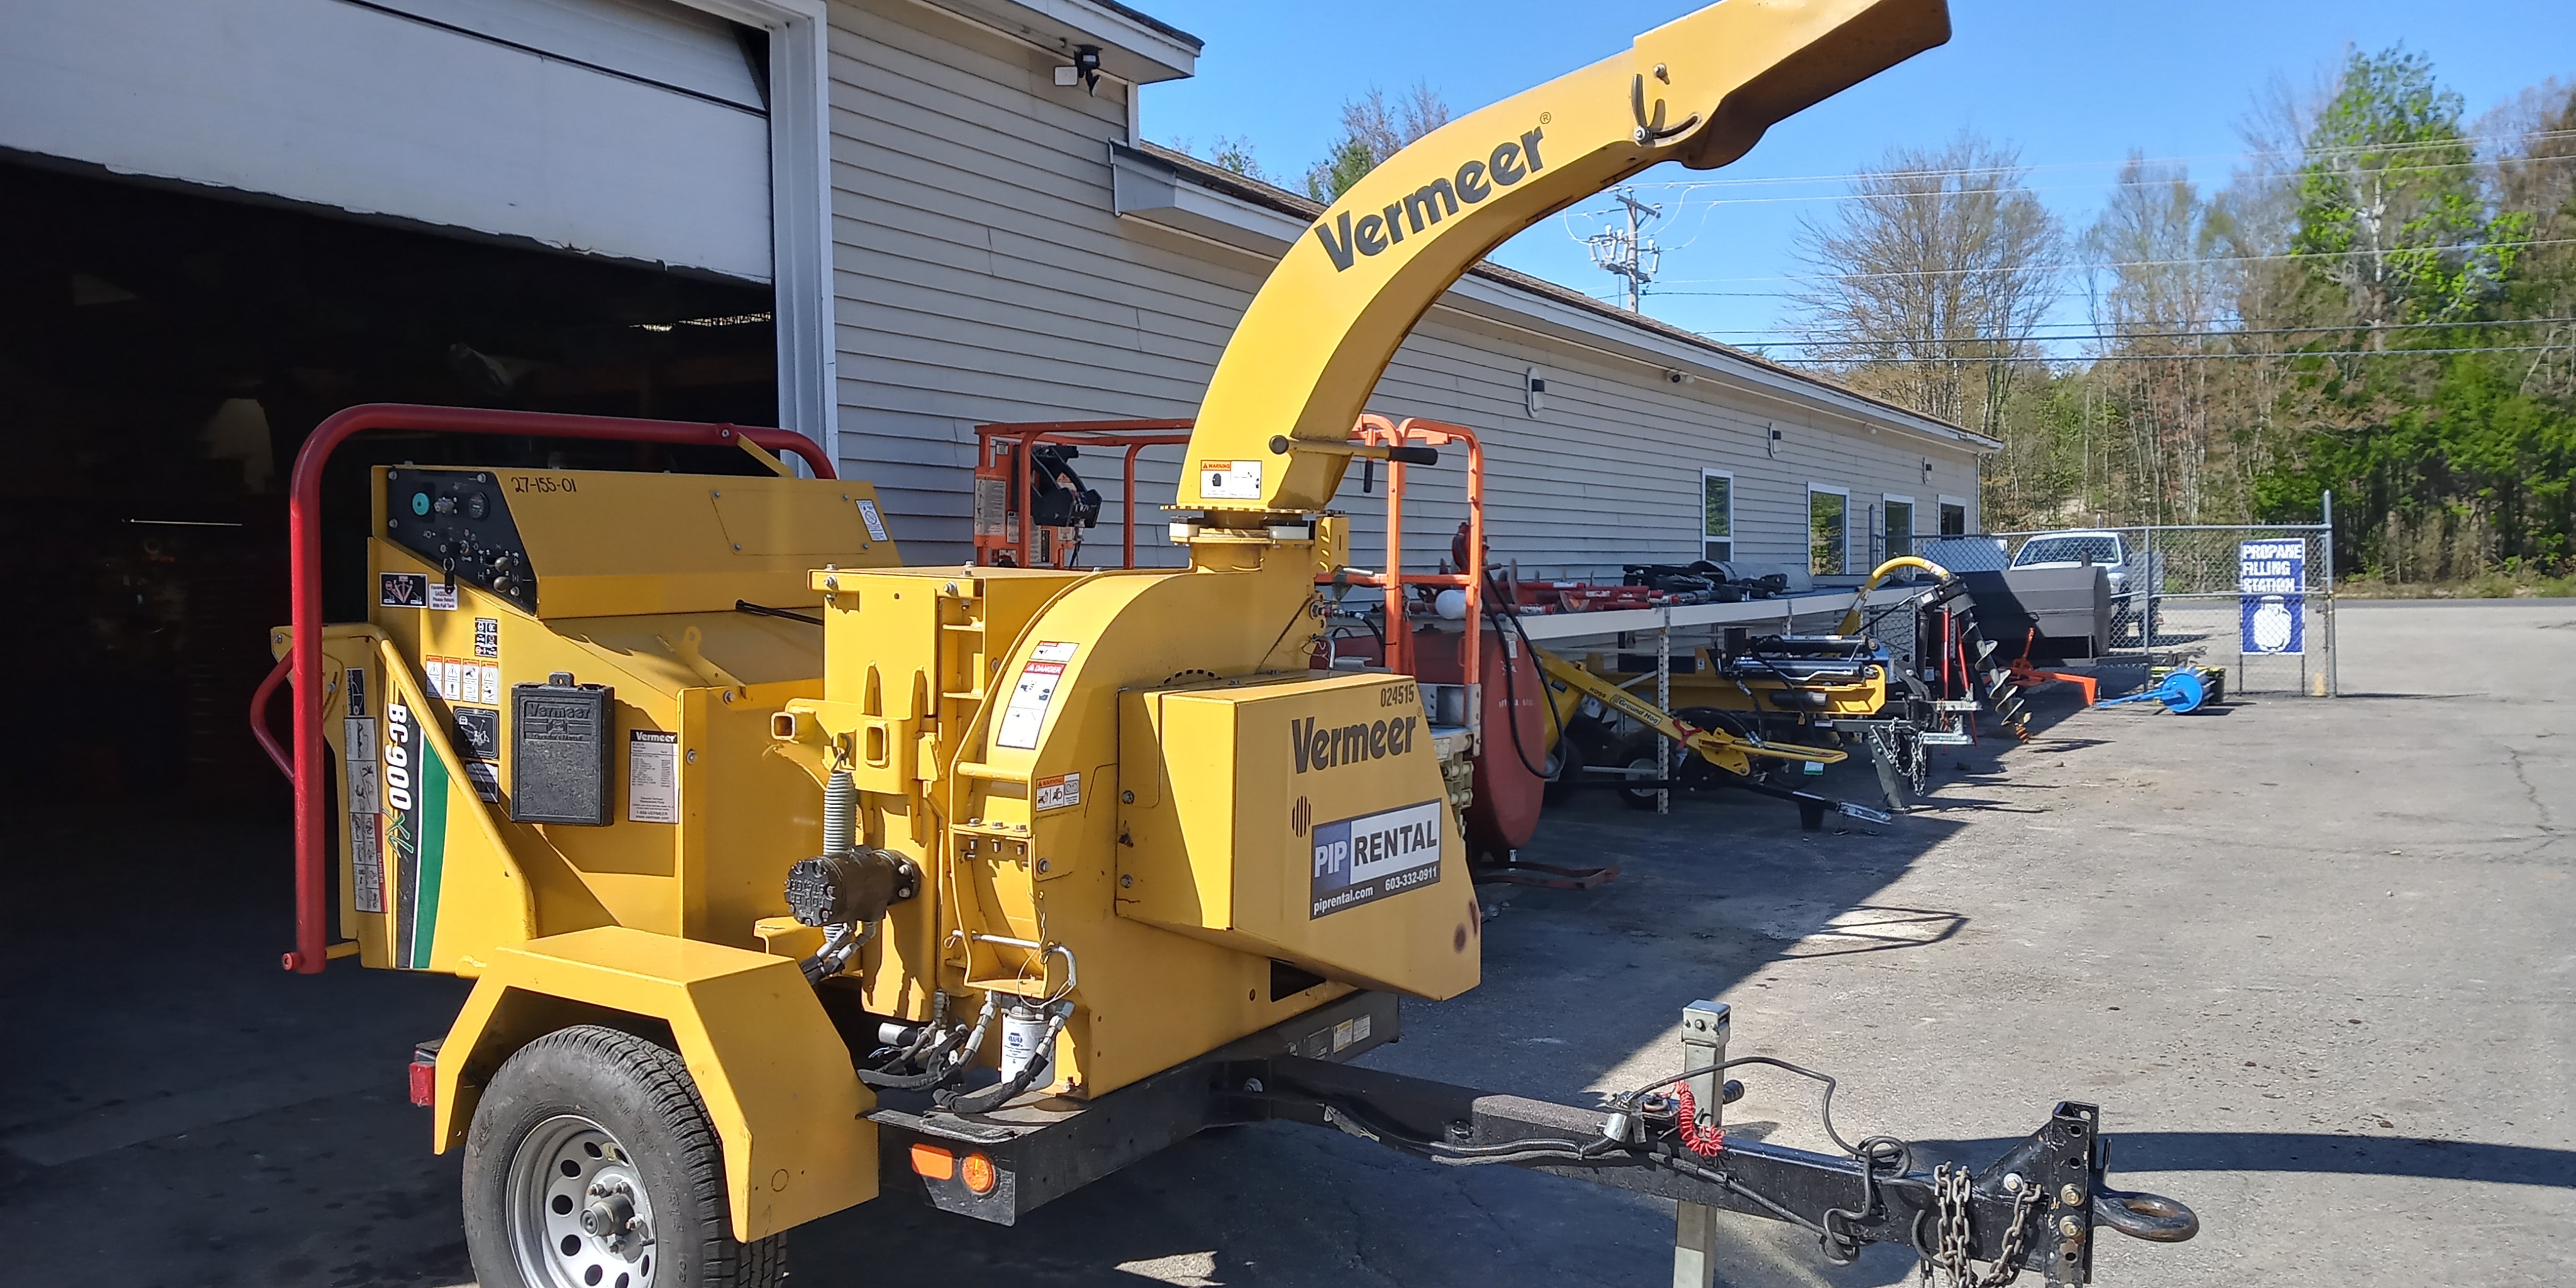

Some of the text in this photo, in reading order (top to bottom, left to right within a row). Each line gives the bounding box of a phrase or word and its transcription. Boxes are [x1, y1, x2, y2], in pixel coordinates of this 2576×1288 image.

[1314, 126, 1544, 272] Vermeer
[511, 477, 577, 492] 27-155-01
[2243, 544, 2302, 559] PROPANE
[2243, 561, 2290, 575] FILLING
[2243, 578, 2295, 592] STATION
[1035, 665, 1062, 674] DANGER
[1380, 684, 1414, 707] 024515
[527, 702, 591, 719] Vermeer
[1618, 698, 1659, 724] Ground Hog
[636, 731, 675, 743] Vermeer
[1291, 716, 1417, 774] Vermeer
[1314, 820, 1437, 878] PIP RENTAL
[1313, 865, 1437, 916] piprental.com 603-332-0911
